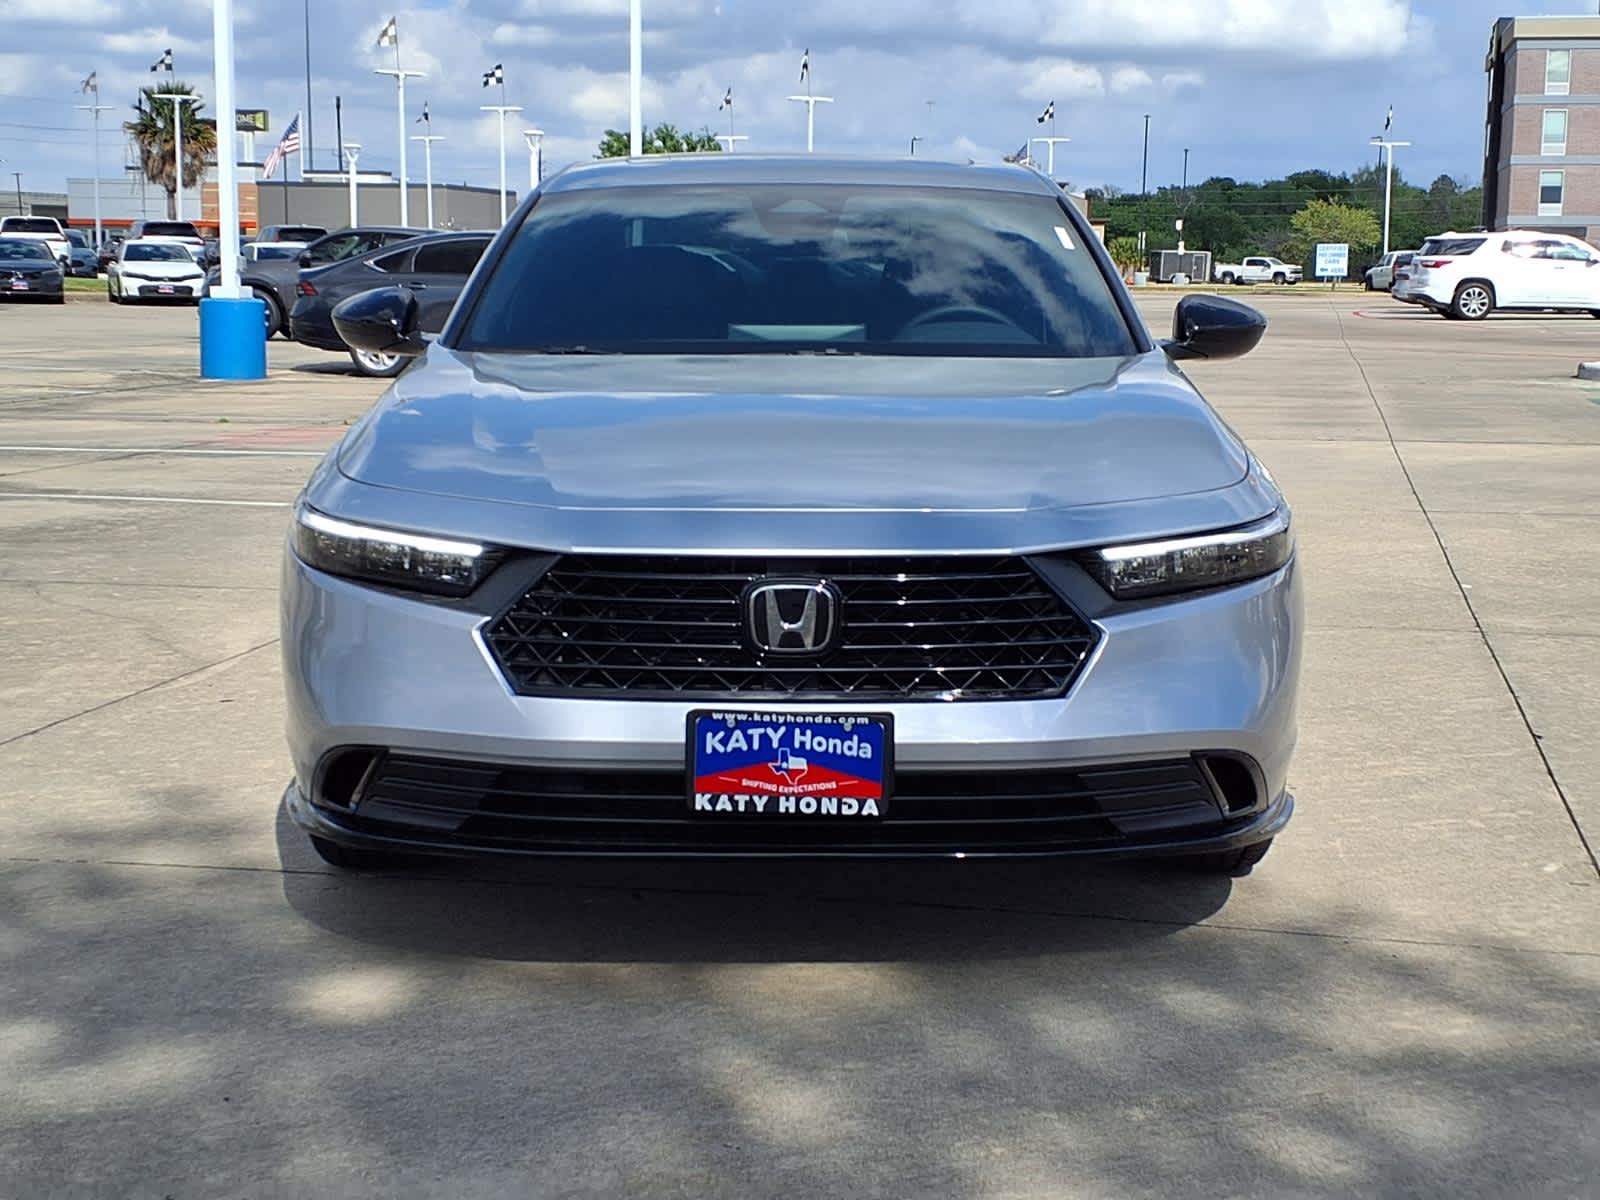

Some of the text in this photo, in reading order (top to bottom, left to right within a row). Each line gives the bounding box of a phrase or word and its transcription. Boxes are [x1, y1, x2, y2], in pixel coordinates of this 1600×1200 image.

[711, 711, 869, 725] www.katyhonda.com
[705, 726, 872, 759] KATY Honda
[741, 778, 837, 793] SHIFTING EXPECTATIONS
[695, 793, 880, 816] KATY HONDA
